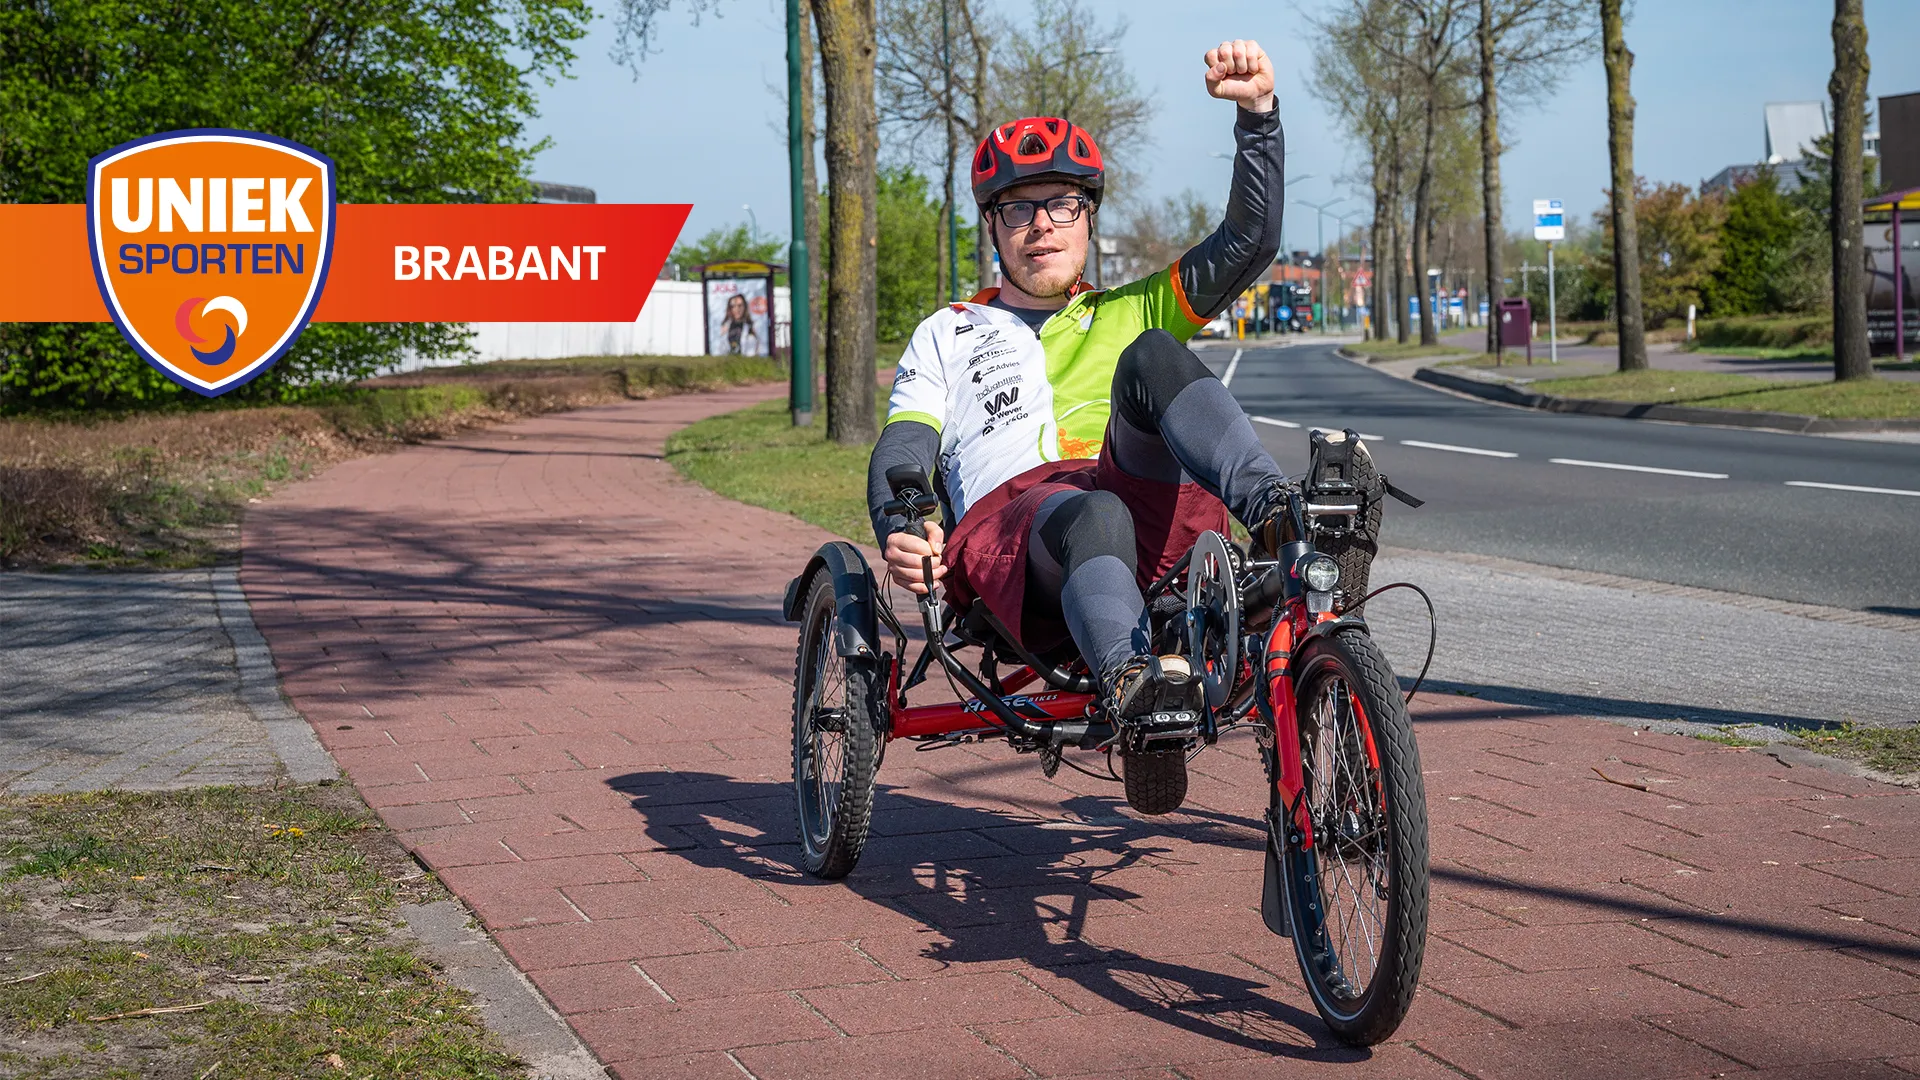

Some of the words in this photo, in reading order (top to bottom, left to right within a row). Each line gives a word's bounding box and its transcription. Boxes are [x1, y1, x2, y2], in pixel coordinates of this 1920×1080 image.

[996, 361, 1020, 371] Advies
[997, 406, 1023, 419] Wever
[1028, 694, 1058, 703] BIKES
